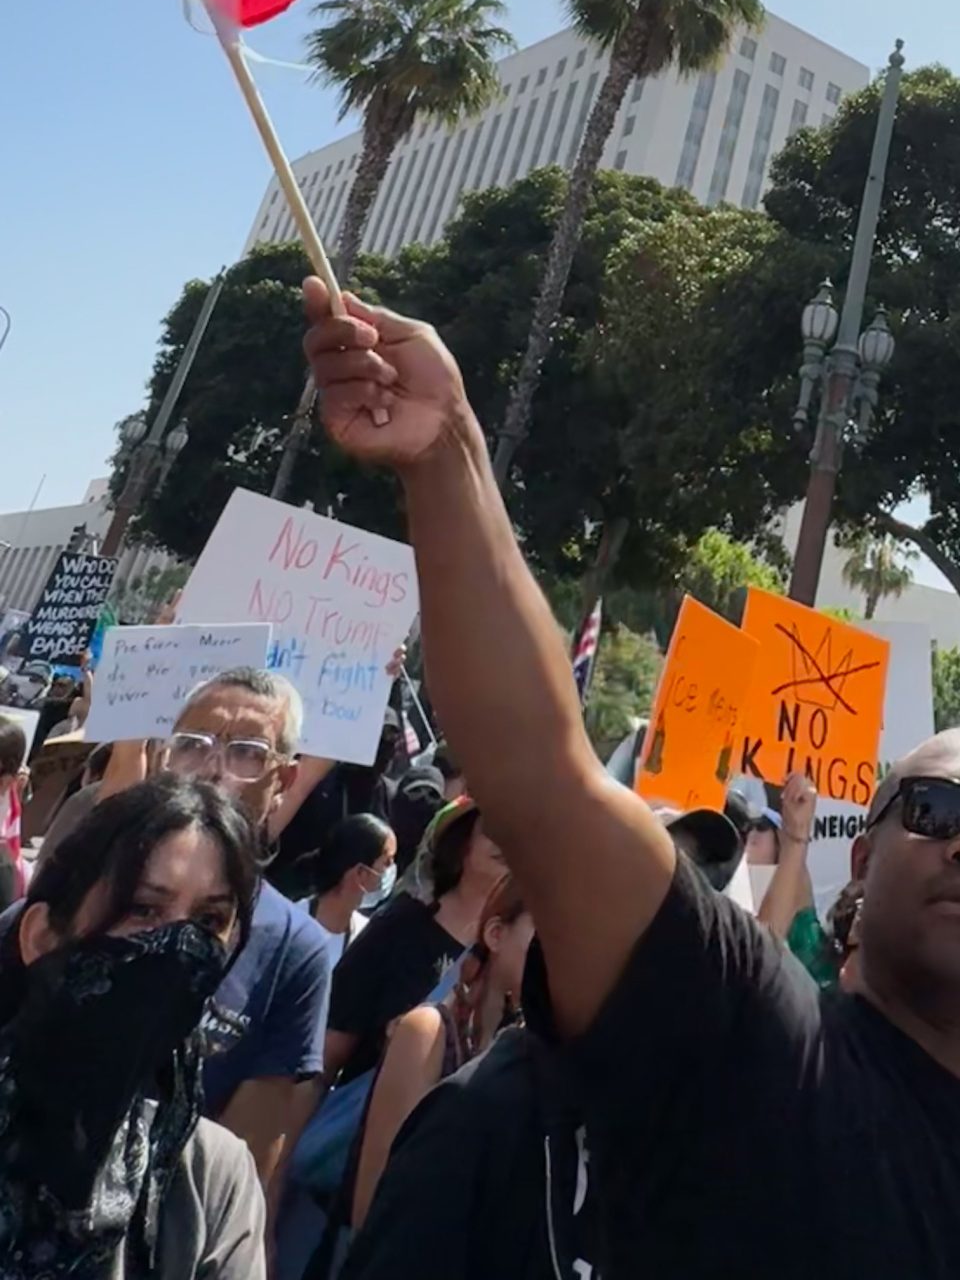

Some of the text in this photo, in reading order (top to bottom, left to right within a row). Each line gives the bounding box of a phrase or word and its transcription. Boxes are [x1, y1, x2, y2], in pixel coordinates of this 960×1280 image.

[55, 574, 80, 588] YOU
[268, 517, 408, 607] No Kings
[778, 699, 828, 750] NO
[741, 736, 874, 806] KINGS
